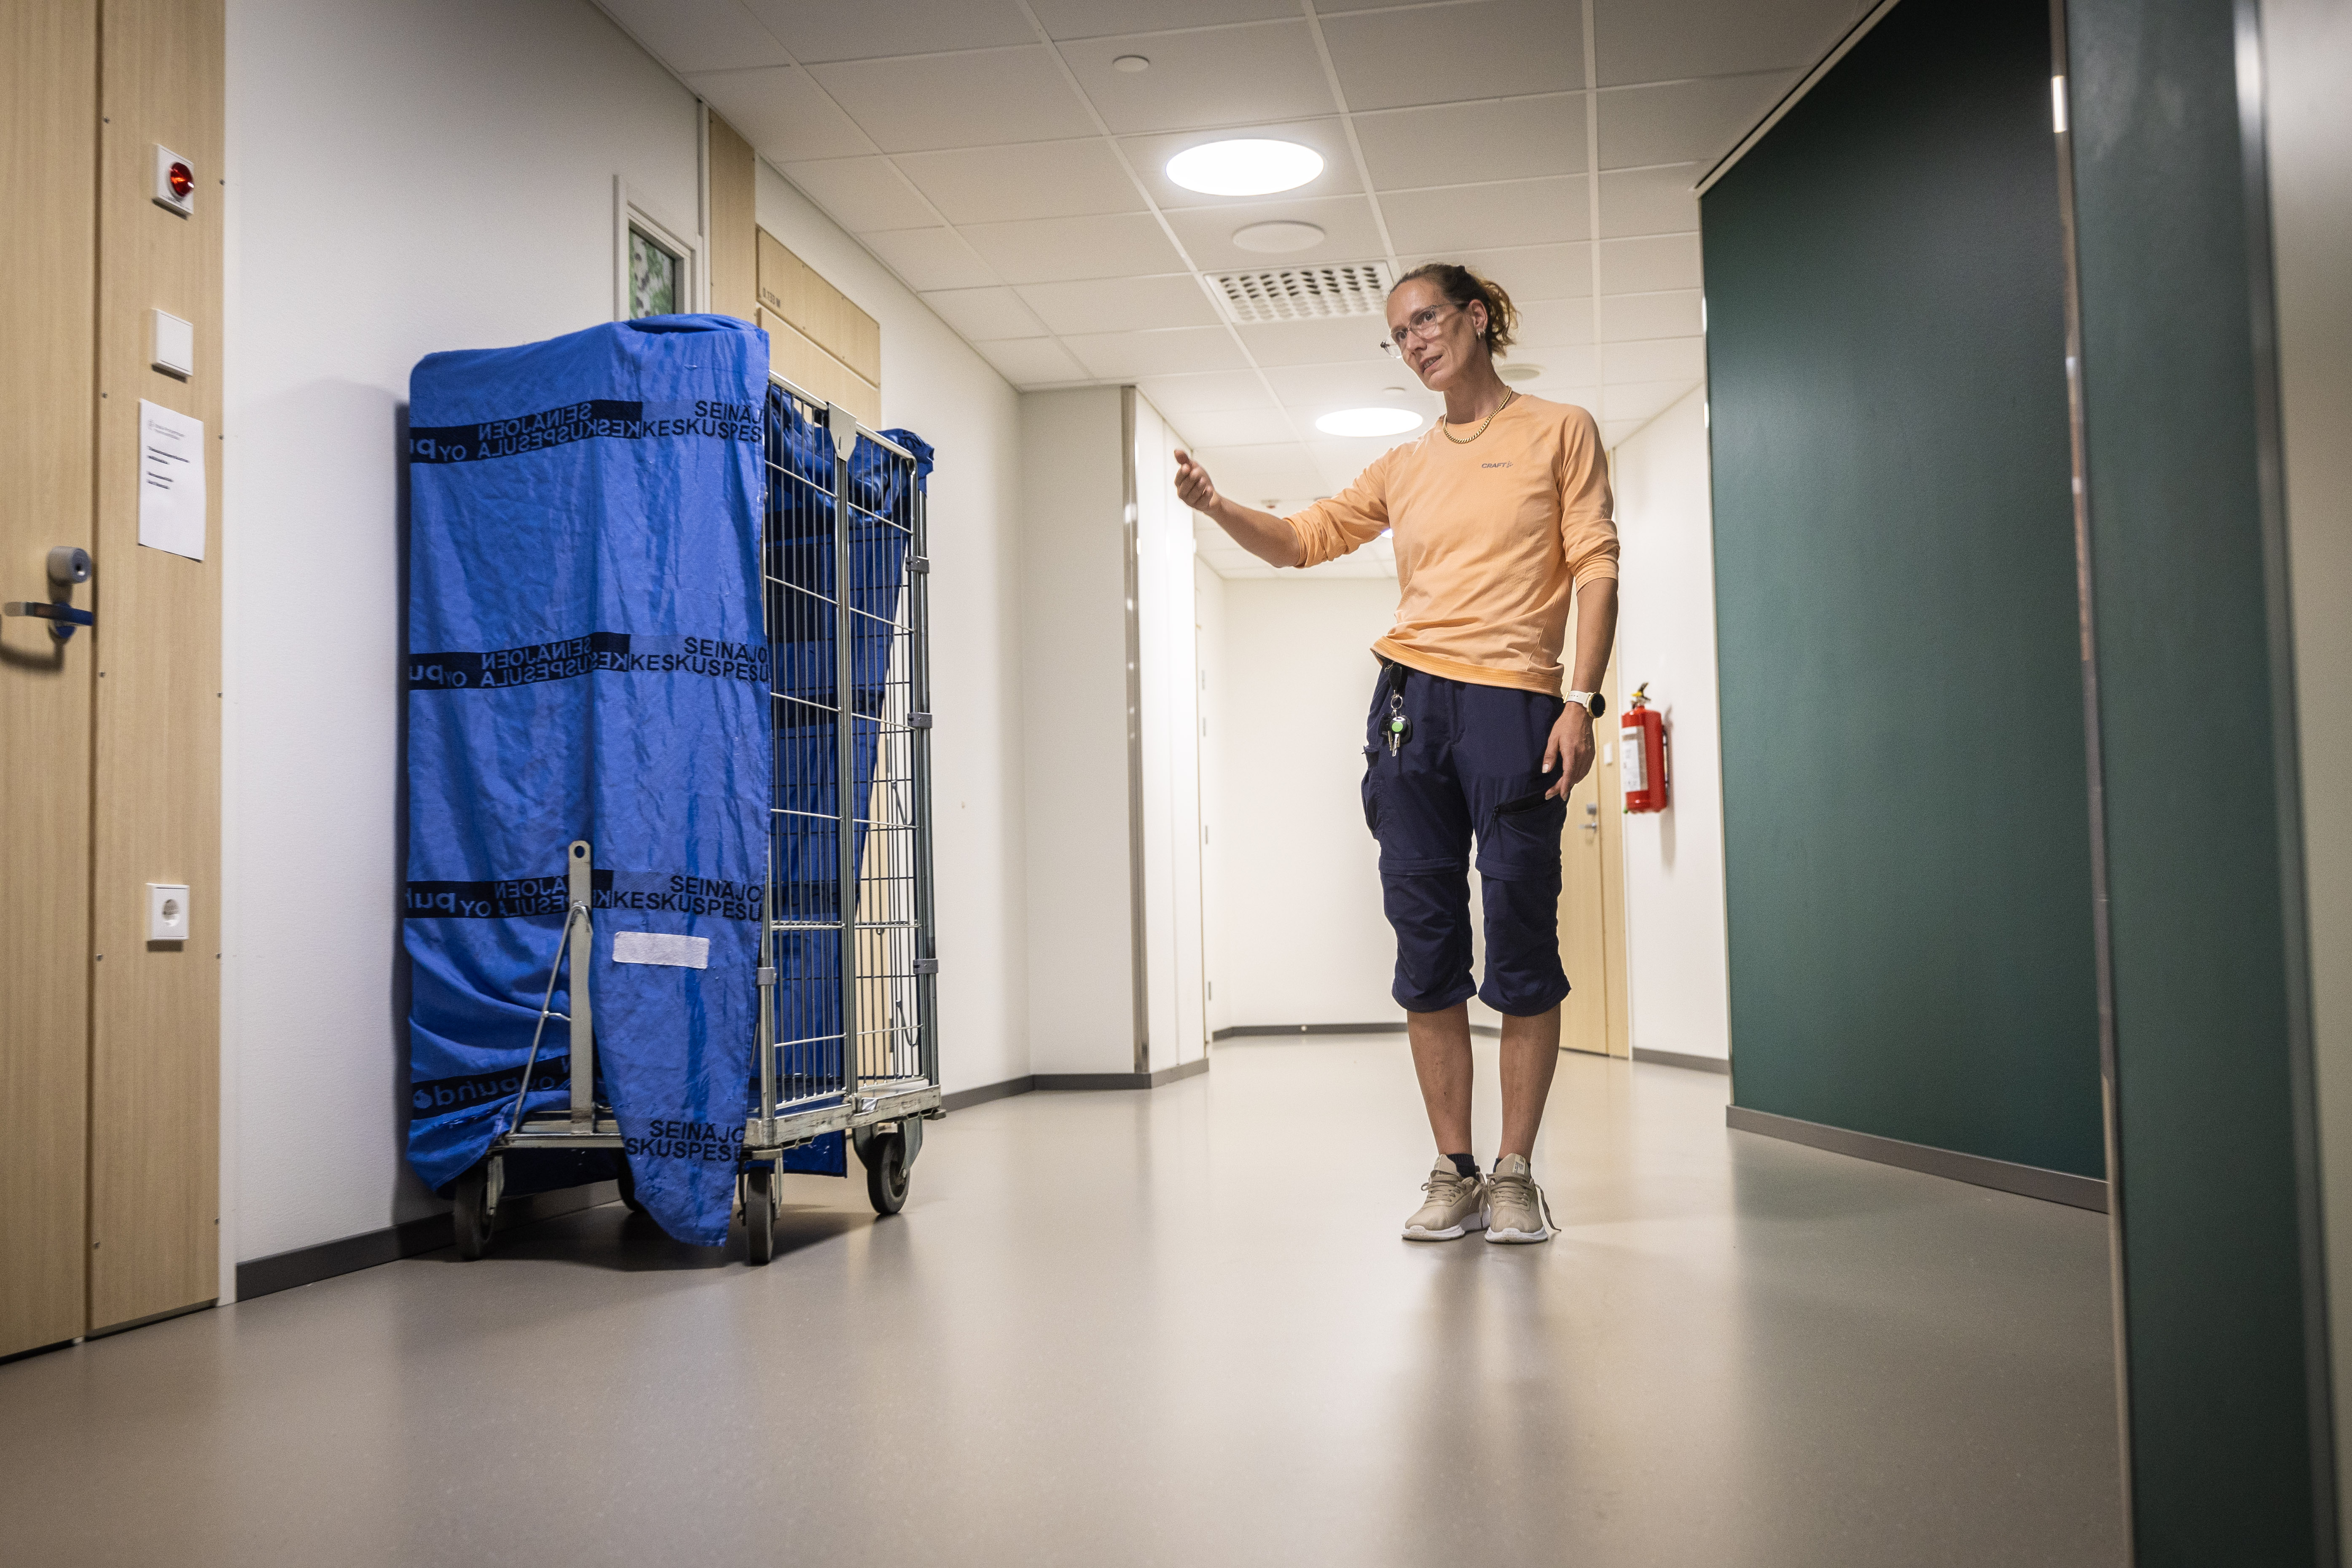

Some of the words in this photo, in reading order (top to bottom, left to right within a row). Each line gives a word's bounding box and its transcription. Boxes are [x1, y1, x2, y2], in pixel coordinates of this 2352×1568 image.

[643, 418, 762, 442] KESKUSPES
[685, 637, 767, 663] SEINÄJO
[631, 654, 769, 682] KESKUSPESU
[615, 891, 763, 921] KESKUSPESU
